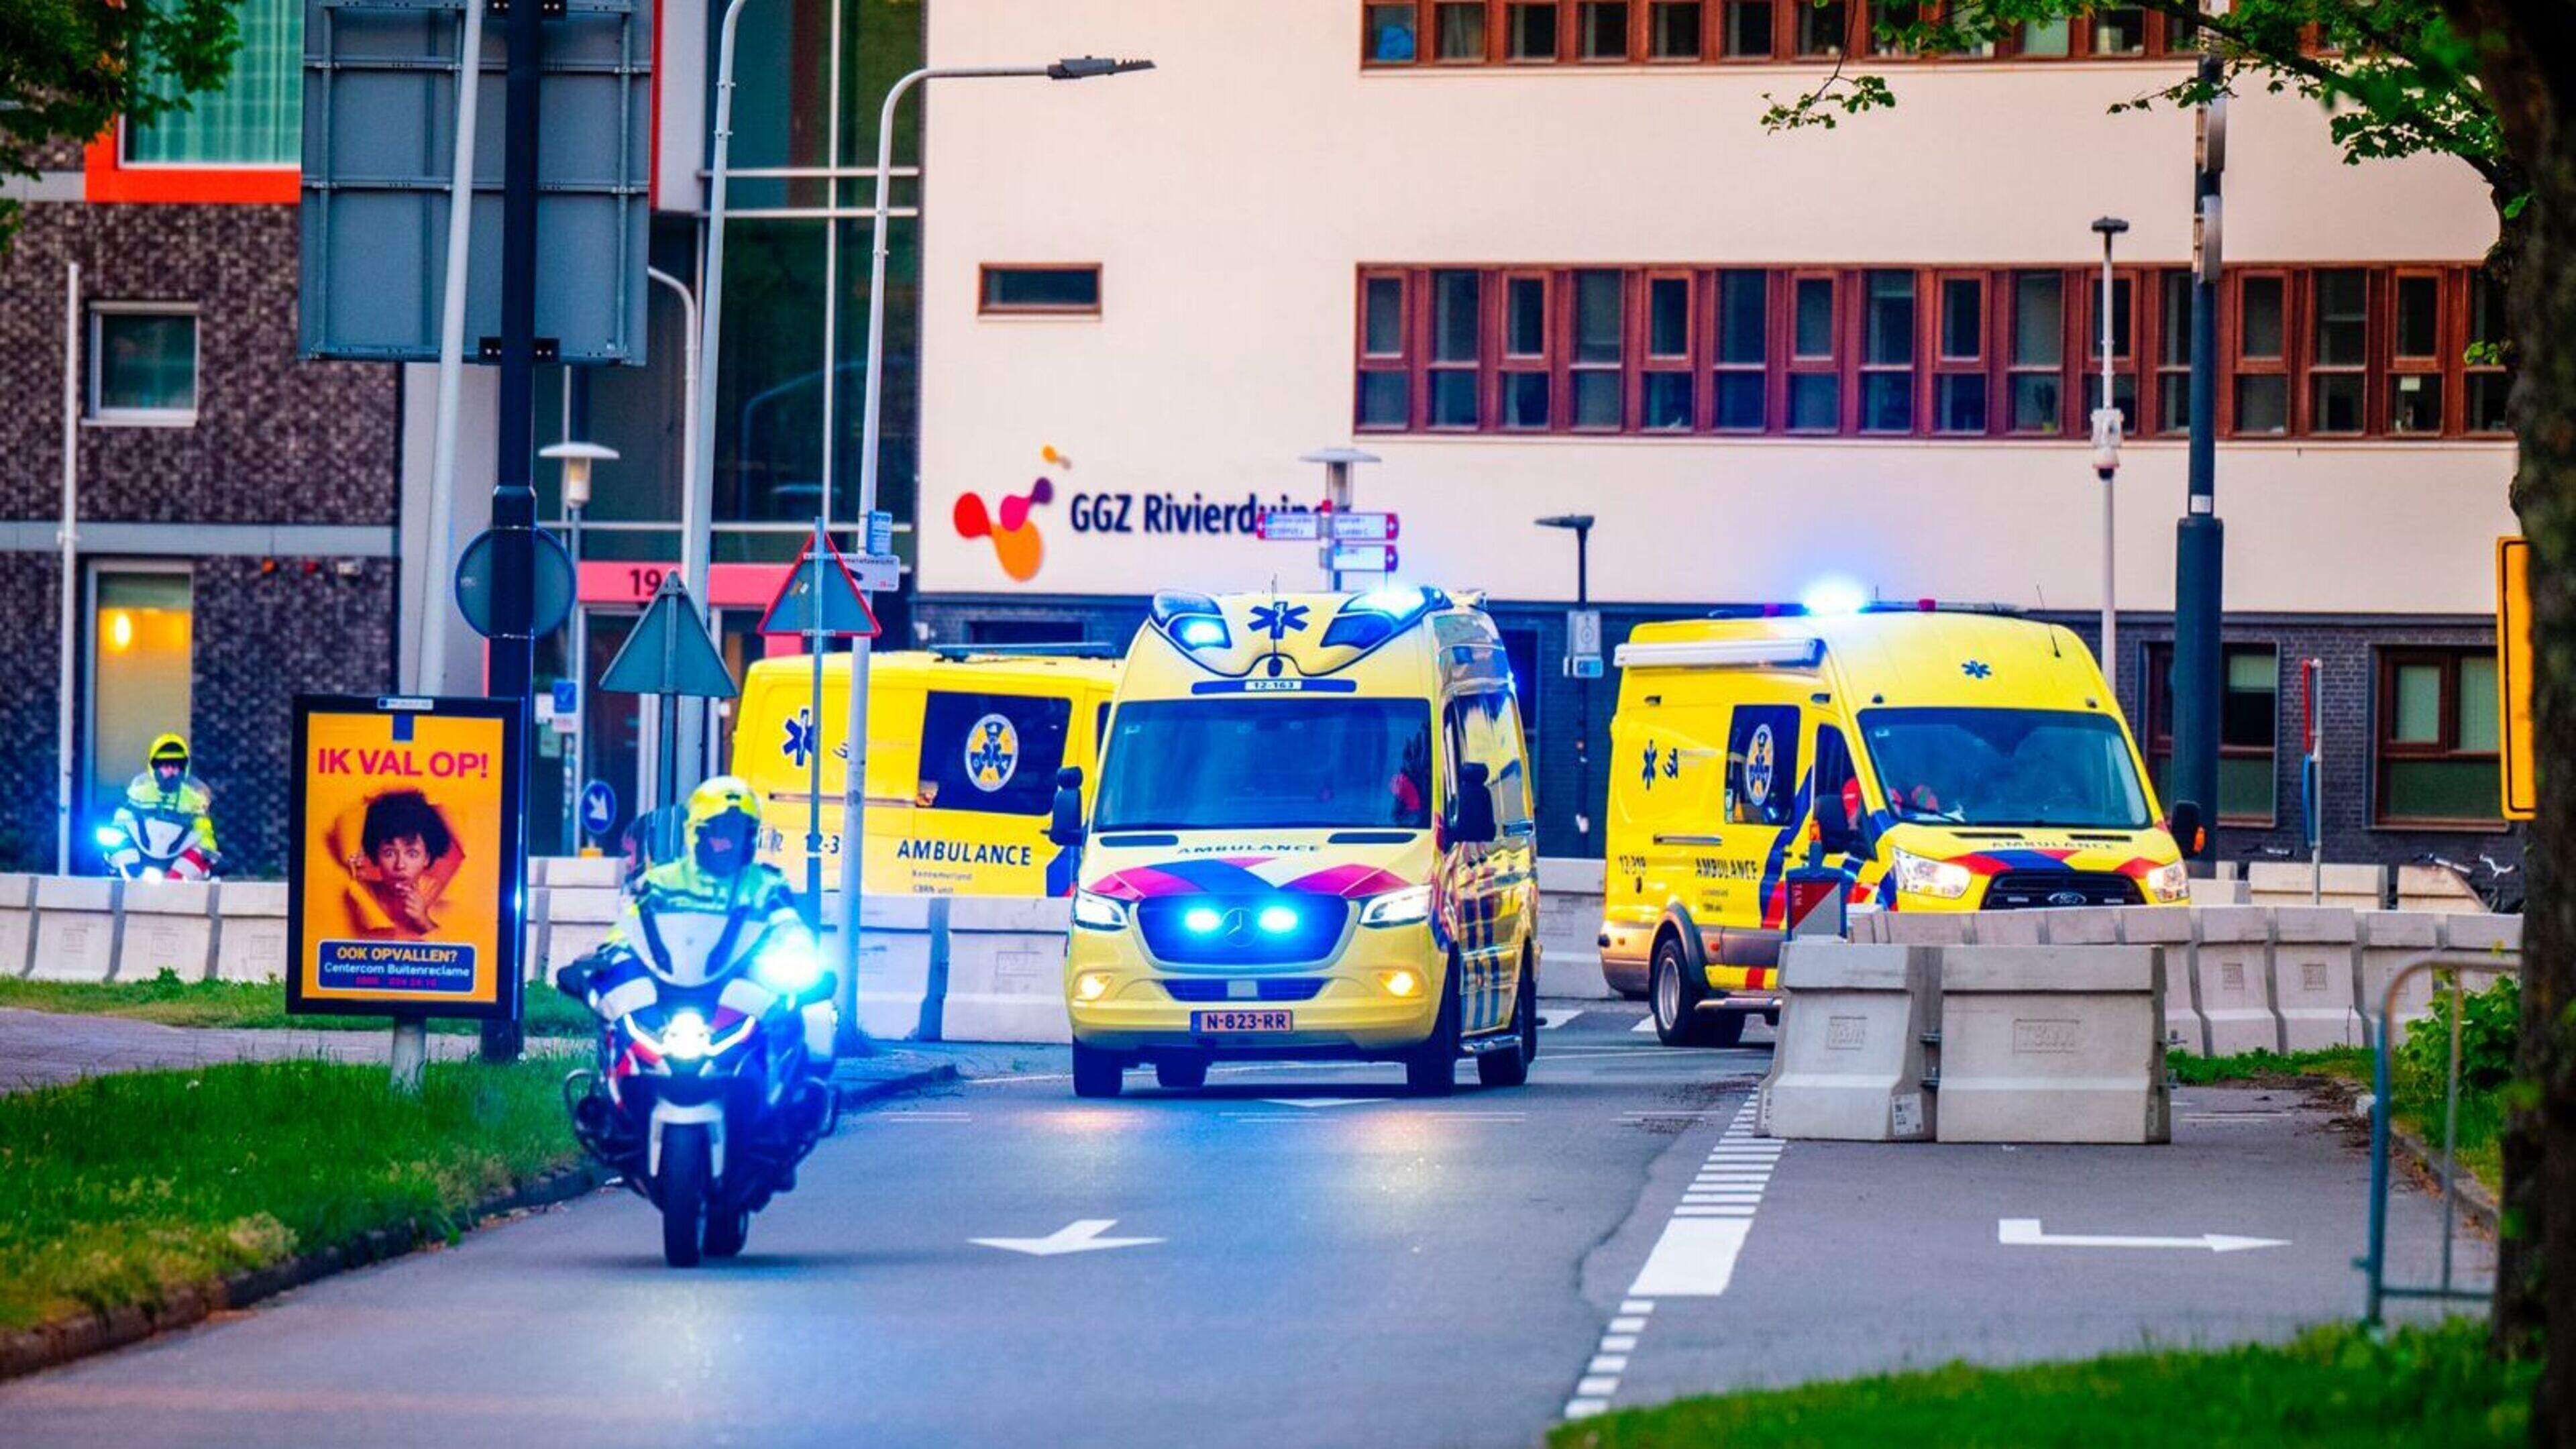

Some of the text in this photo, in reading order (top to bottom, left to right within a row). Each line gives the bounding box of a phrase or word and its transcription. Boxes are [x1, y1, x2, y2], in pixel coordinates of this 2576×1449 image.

[1071, 493, 1132, 533] GGZ
[629, 568, 662, 596] 19
[318, 748, 488, 778] IK VAL OP!
[897, 839, 1031, 866] AMBULANCE
[1177, 844, 1320, 854] AMBULANCE
[1695, 857, 1758, 880] AMBULANCE
[337, 947, 458, 962] OOK OPVALLEN?
[324, 962, 470, 977] Centercom Buitenreclame
[1207, 1014, 1286, 1029] N-823-RR
